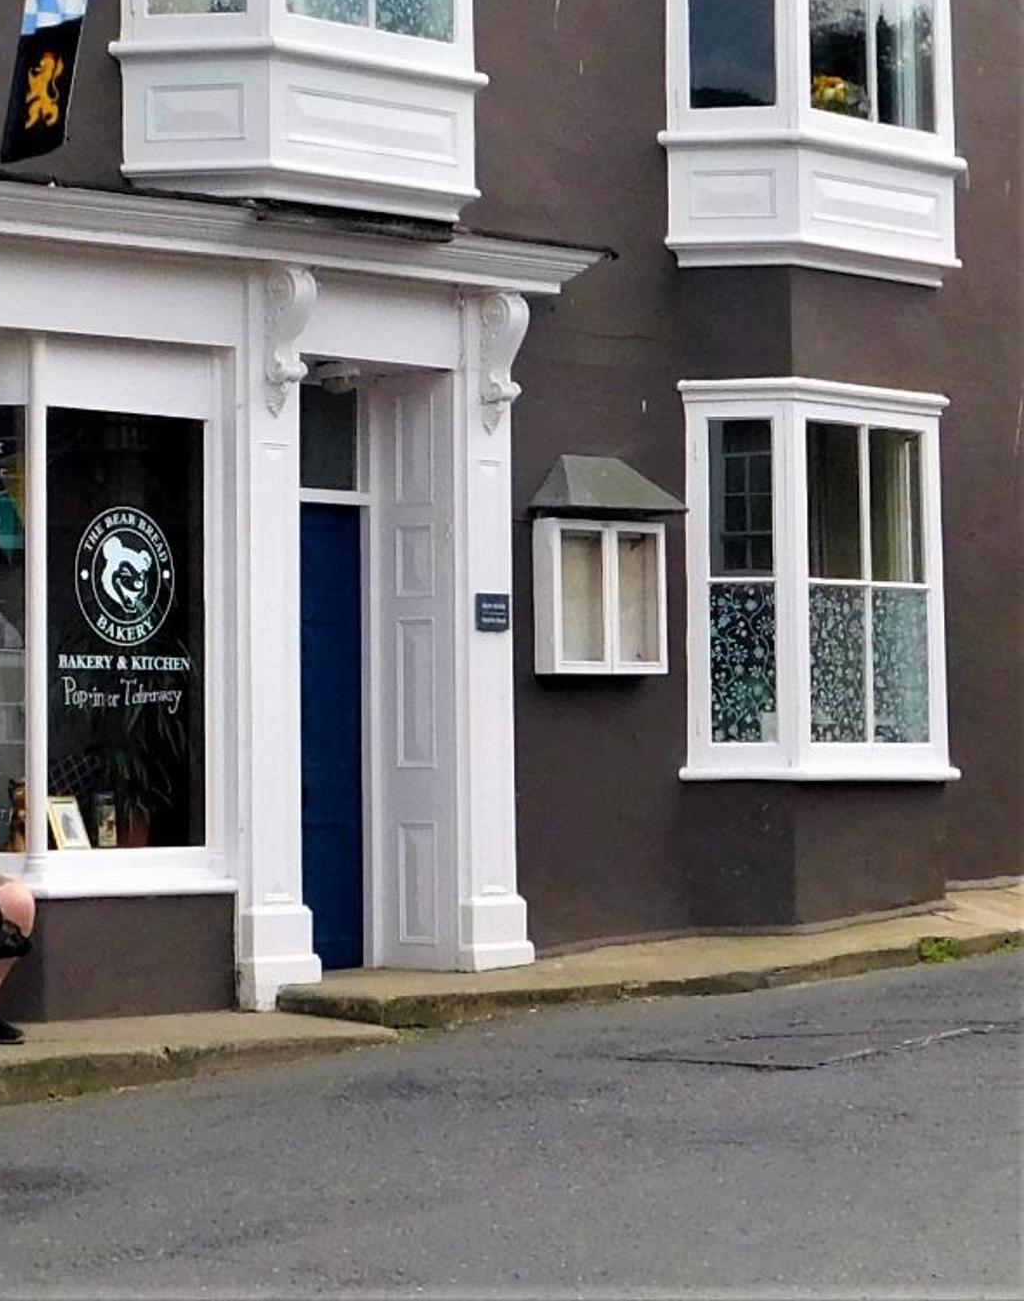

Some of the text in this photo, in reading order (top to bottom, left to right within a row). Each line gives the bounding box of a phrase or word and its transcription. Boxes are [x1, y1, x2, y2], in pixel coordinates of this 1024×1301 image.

[84, 513, 168, 562] THE BEAR BREAD
[96, 614, 154, 640] BAKERY
[58, 654, 190, 670] BAKERY & KITCHEN
